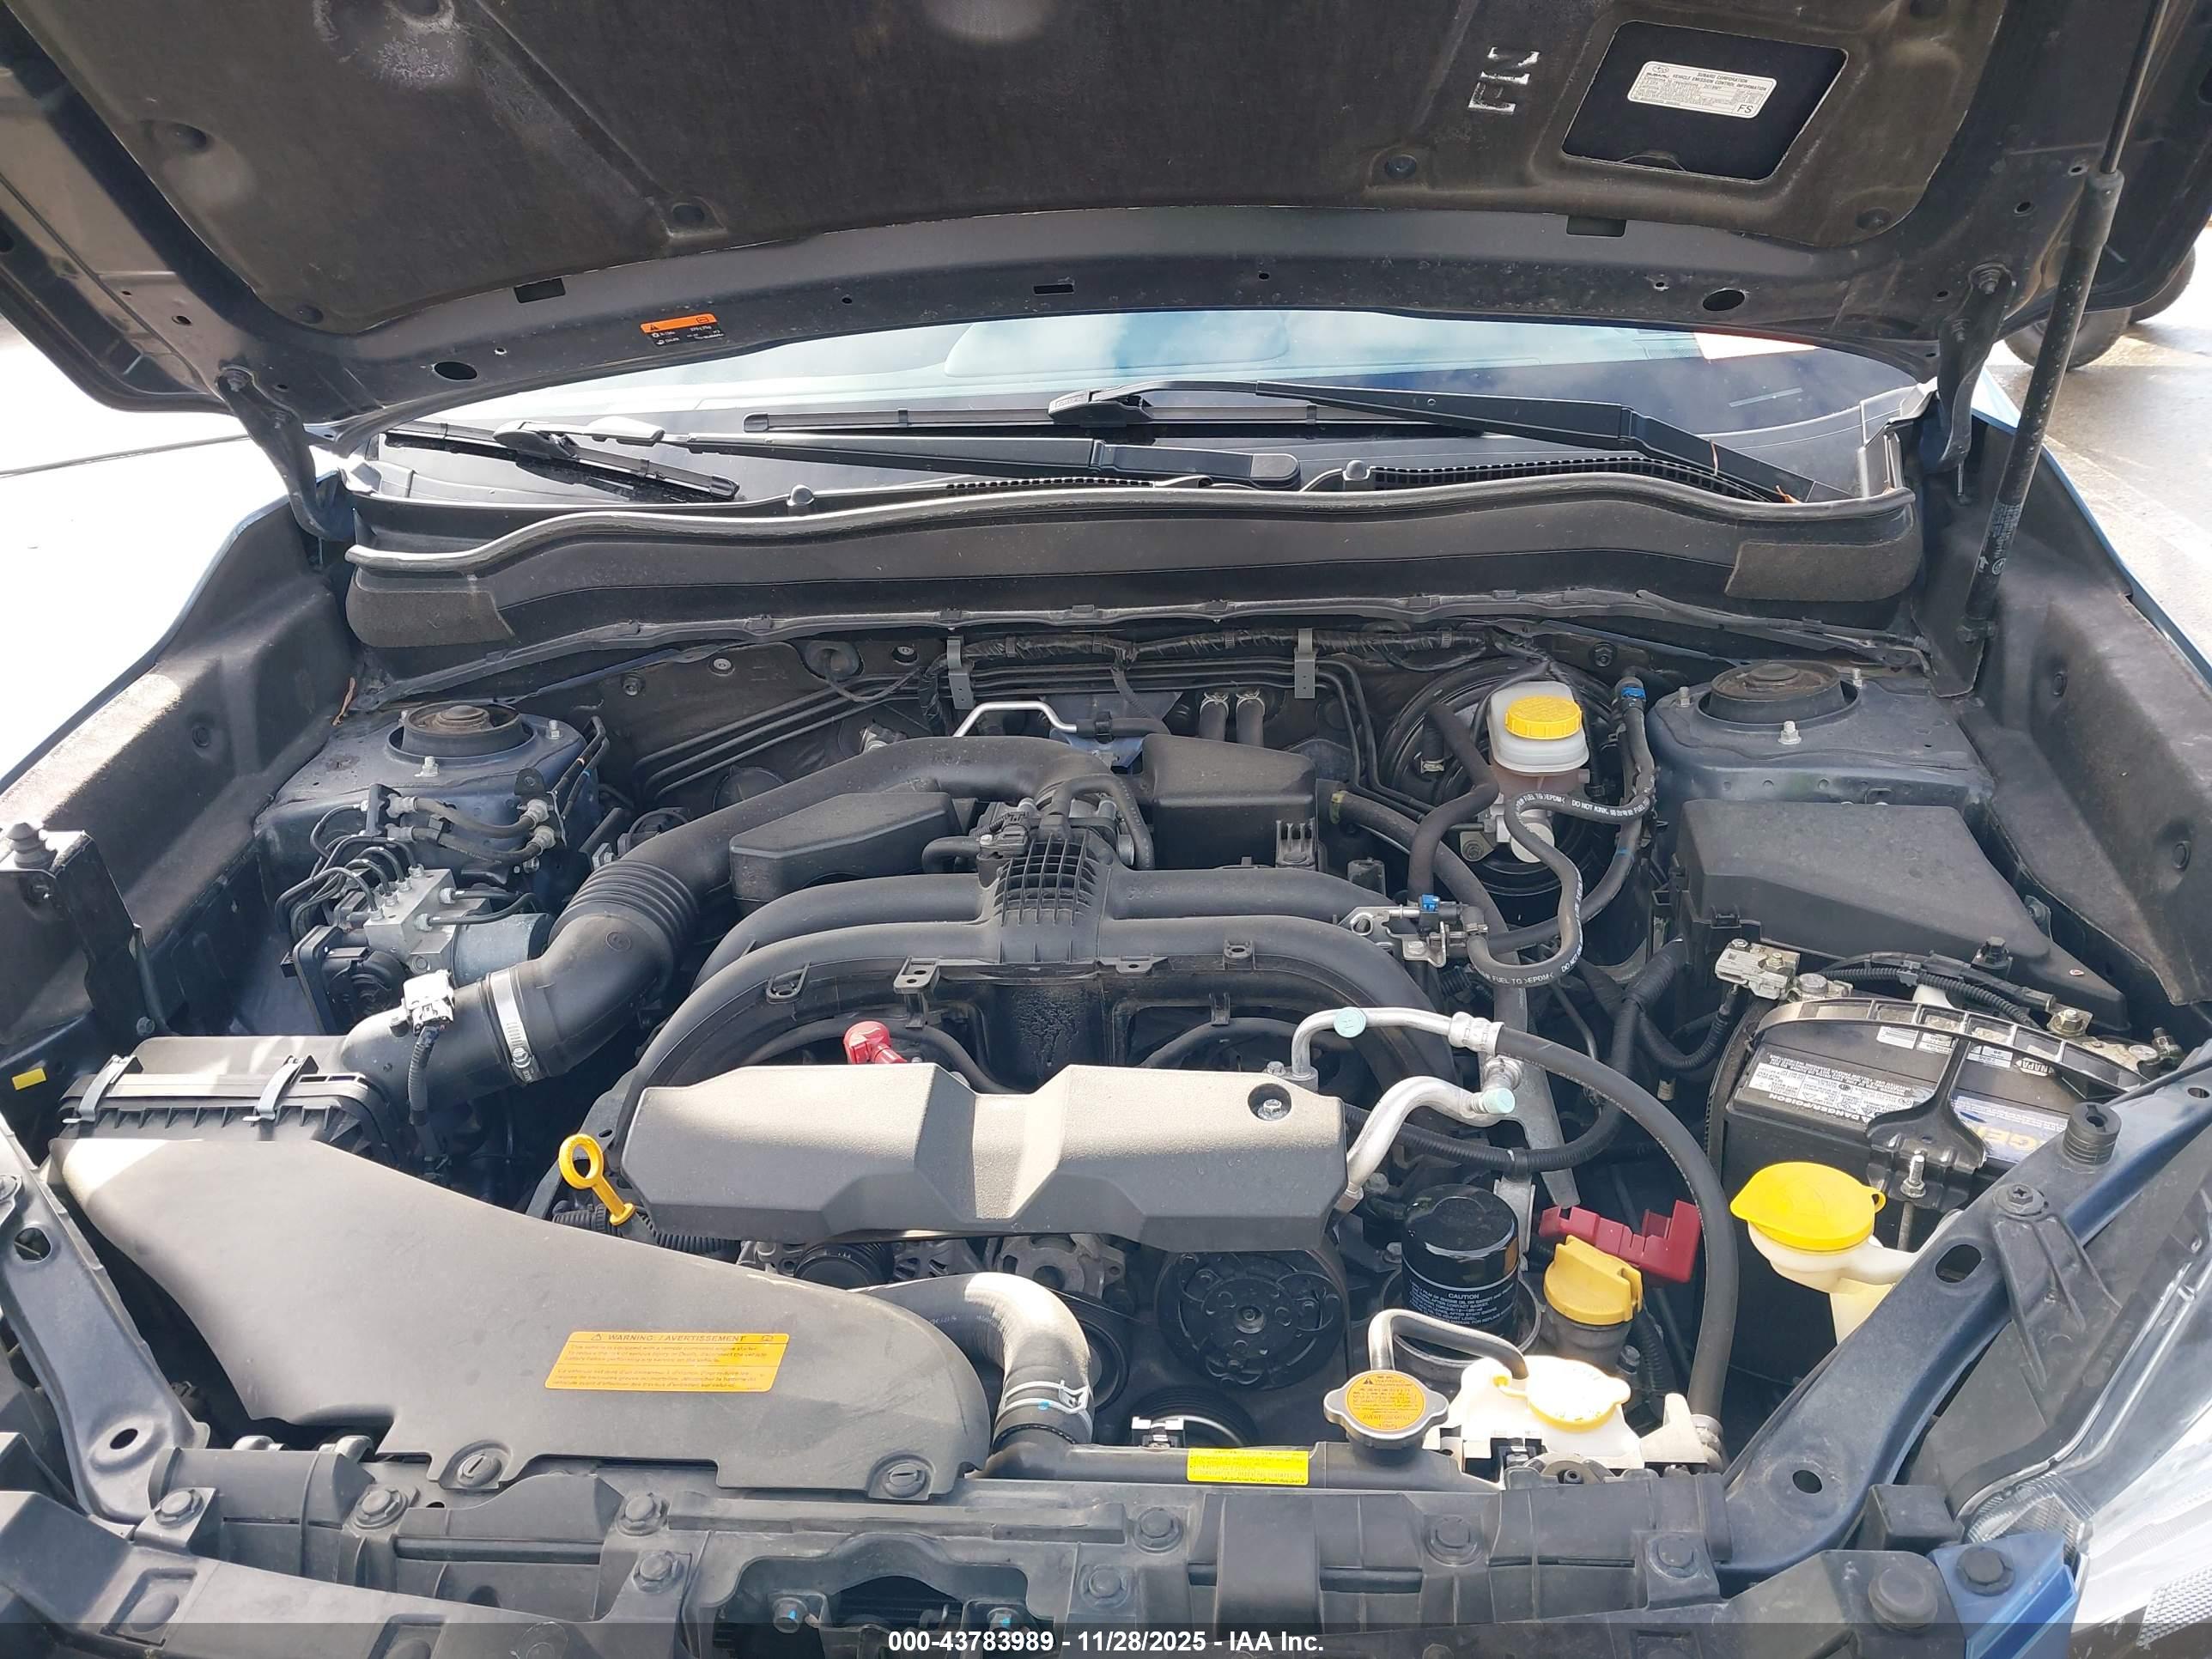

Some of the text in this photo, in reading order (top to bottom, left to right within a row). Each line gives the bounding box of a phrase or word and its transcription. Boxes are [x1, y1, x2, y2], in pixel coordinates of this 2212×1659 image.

[1737, 104, 1753, 113] FS
[1571, 799, 1580, 808] DO
[1581, 802, 1593, 811] NOT
[1561, 963, 1571, 973] DO
[1492, 975, 1510, 984] FUEL
[2021, 1060, 2048, 1073] NAPA
[1768, 1092, 1860, 1121] DANGER/POISON
